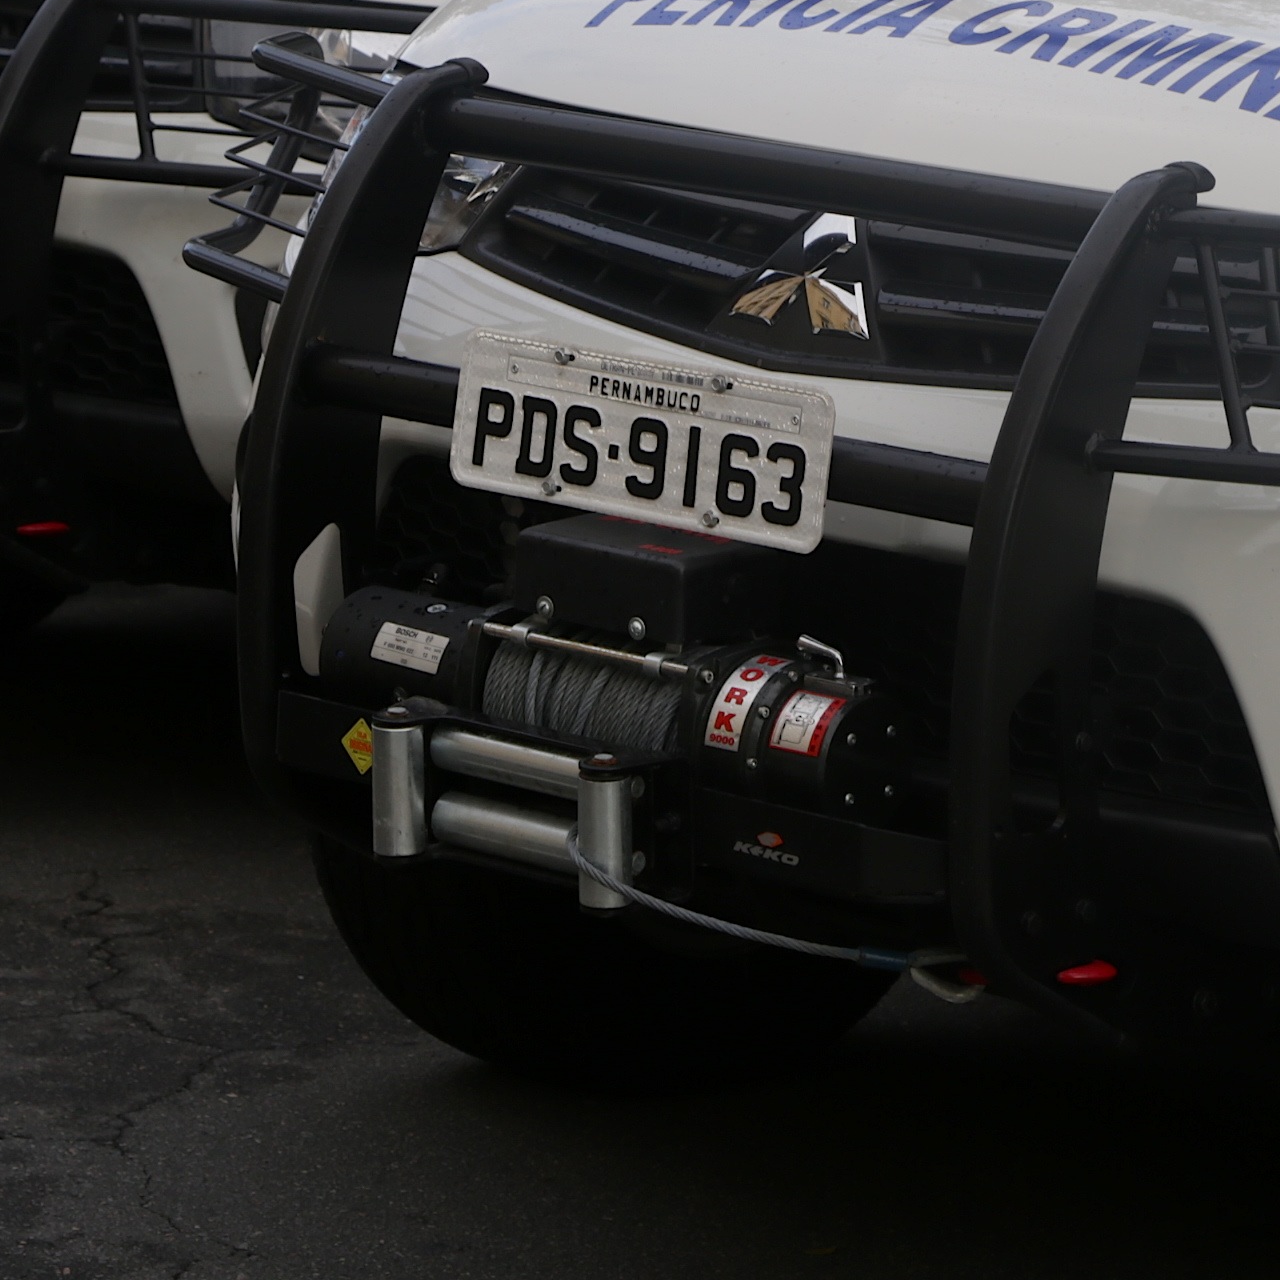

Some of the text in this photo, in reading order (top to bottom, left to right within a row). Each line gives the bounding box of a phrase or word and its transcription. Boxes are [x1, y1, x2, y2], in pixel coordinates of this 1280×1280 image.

[589, 375, 701, 412] PERNAMBUCO
[395, 627, 419, 639] BOSCH
[714, 655, 788, 733] WORK
[709, 733, 735, 746] 9000
